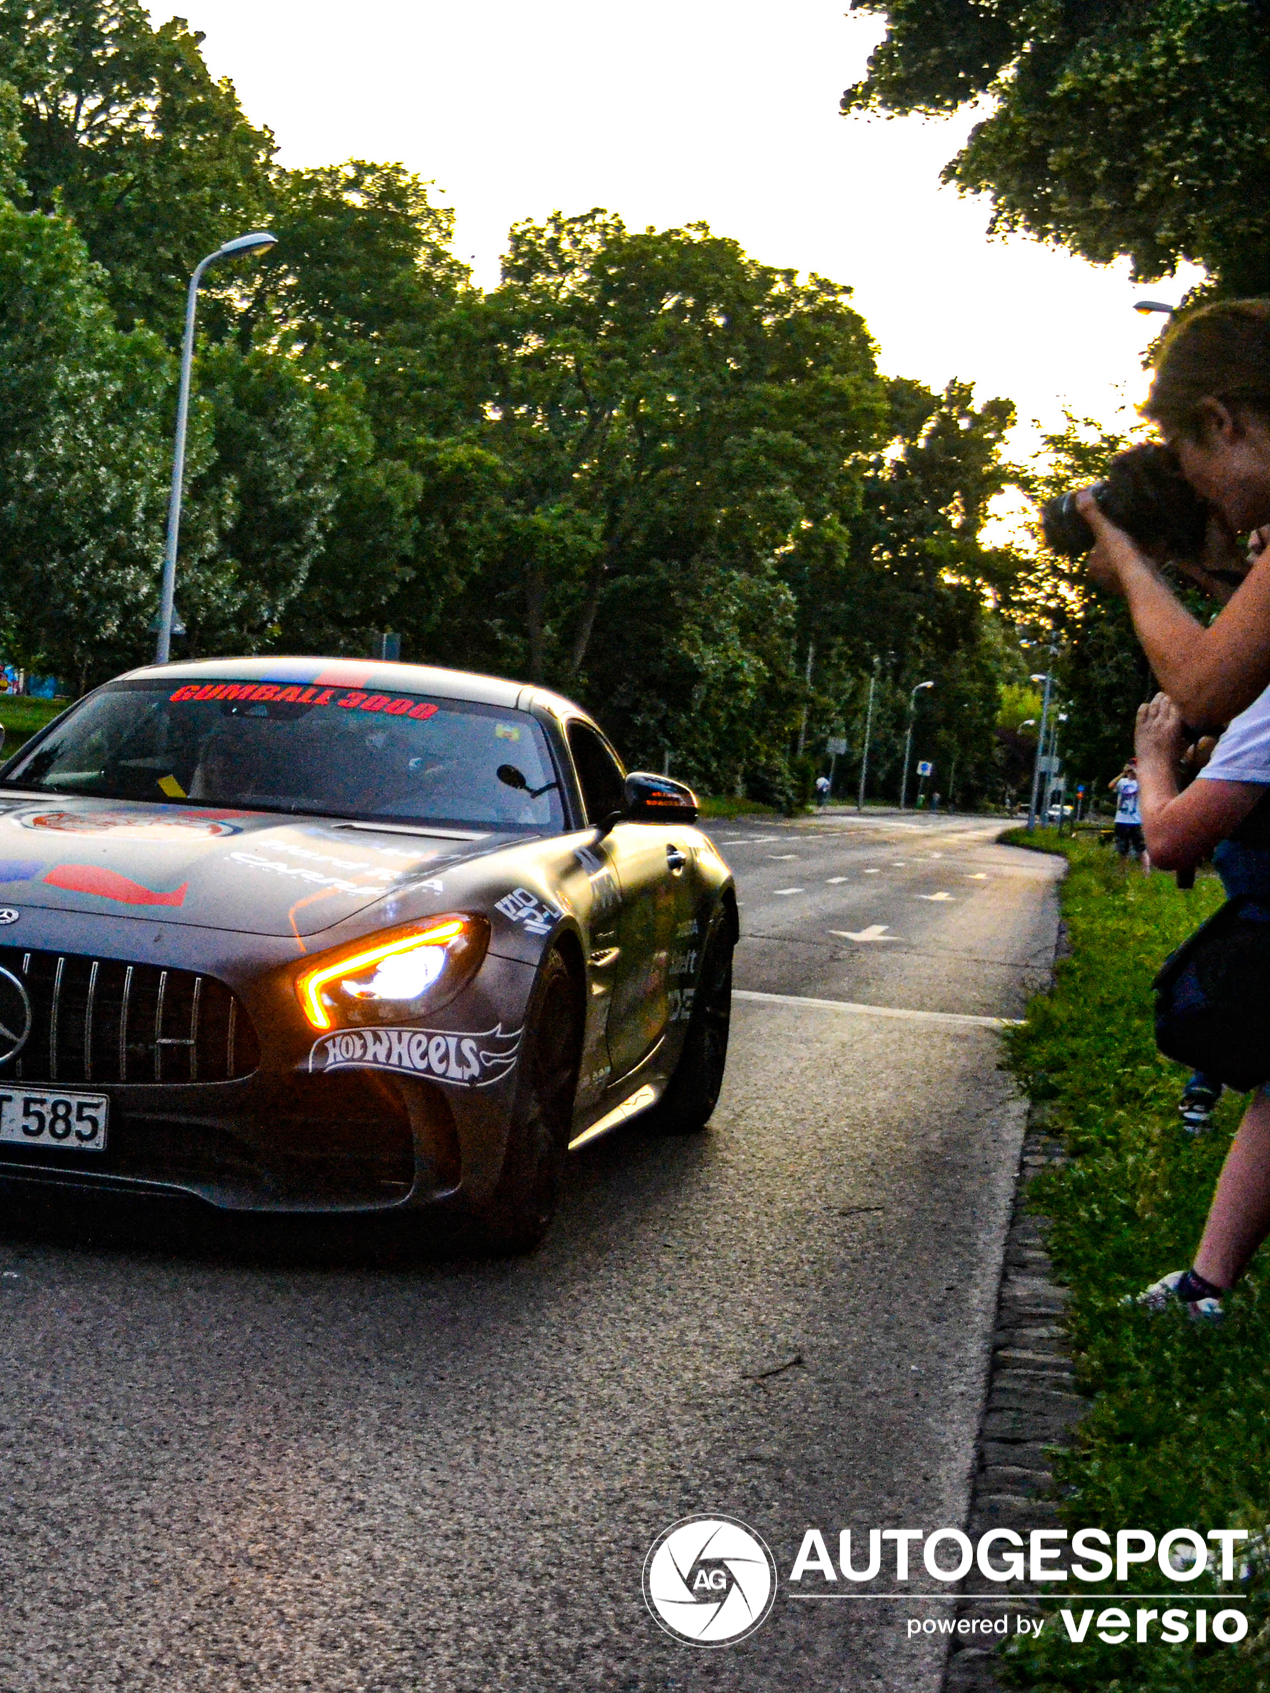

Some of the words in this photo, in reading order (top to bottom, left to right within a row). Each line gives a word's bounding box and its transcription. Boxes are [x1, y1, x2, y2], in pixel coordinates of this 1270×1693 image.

[169, 684, 336, 706] GUMBALL
[337, 692, 439, 720] 3000
[22, 1096, 105, 1142] 585
